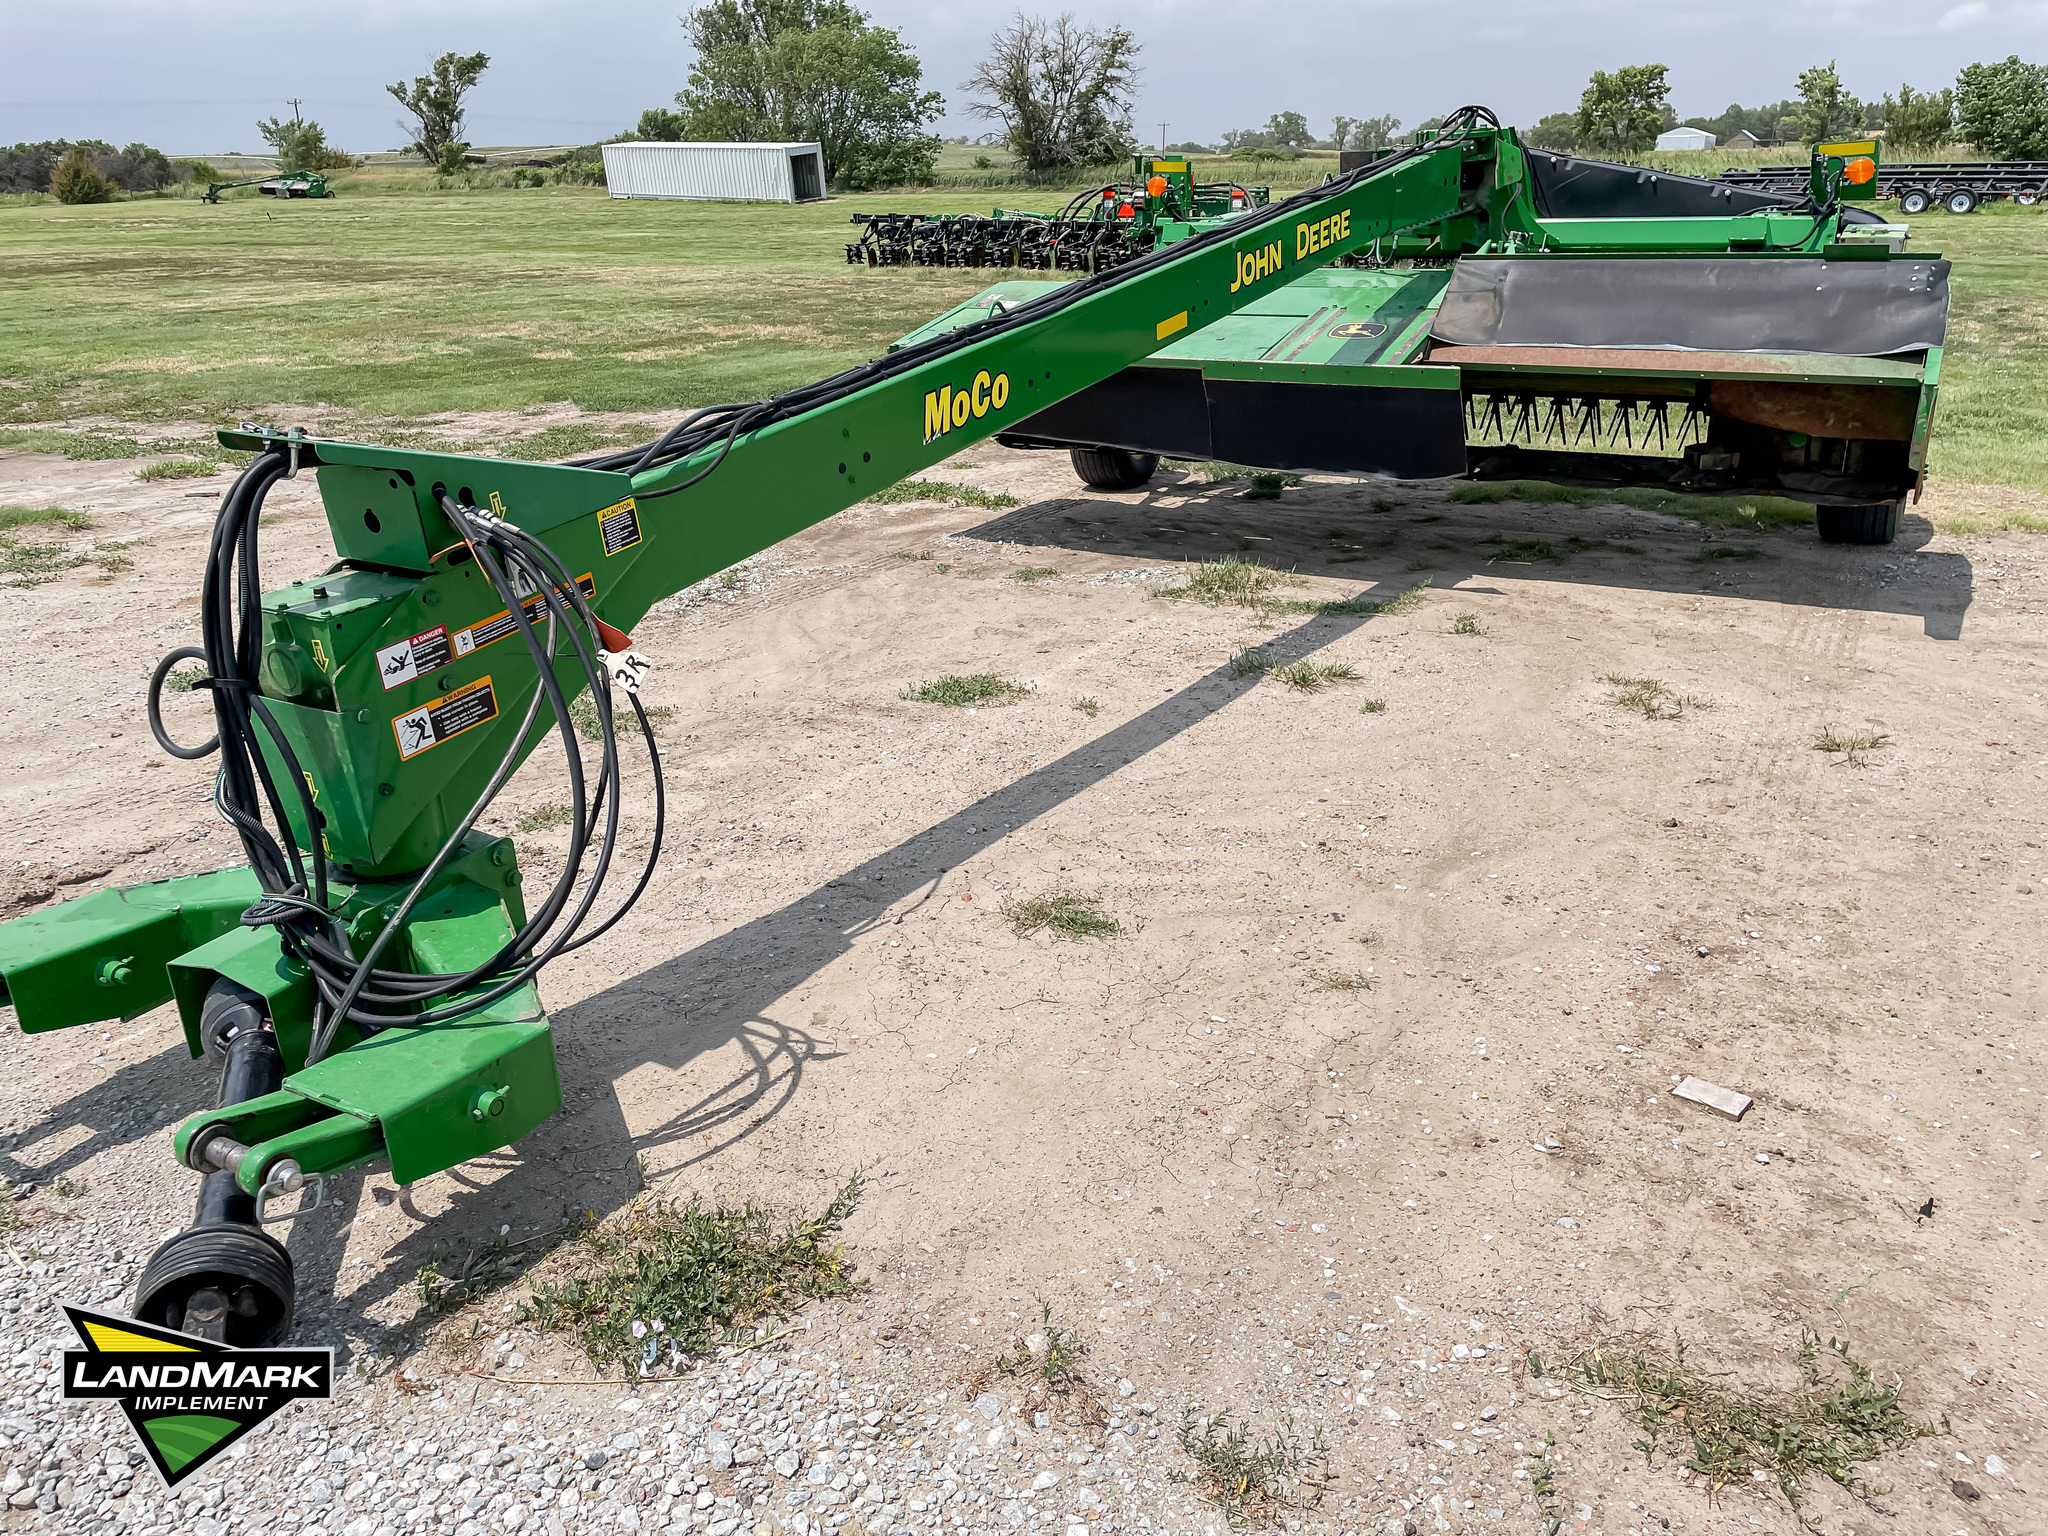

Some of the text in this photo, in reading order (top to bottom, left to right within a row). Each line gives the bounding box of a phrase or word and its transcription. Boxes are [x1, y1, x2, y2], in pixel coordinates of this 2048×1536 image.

[1230, 208, 1351, 294] JOHN DEERE
[923, 369, 1010, 445] MoCo
[606, 501, 632, 517] CAUTION
[523, 594, 545, 607] WARNIN
[418, 627, 443, 642] DANGER
[448, 684, 477, 700] WARNING
